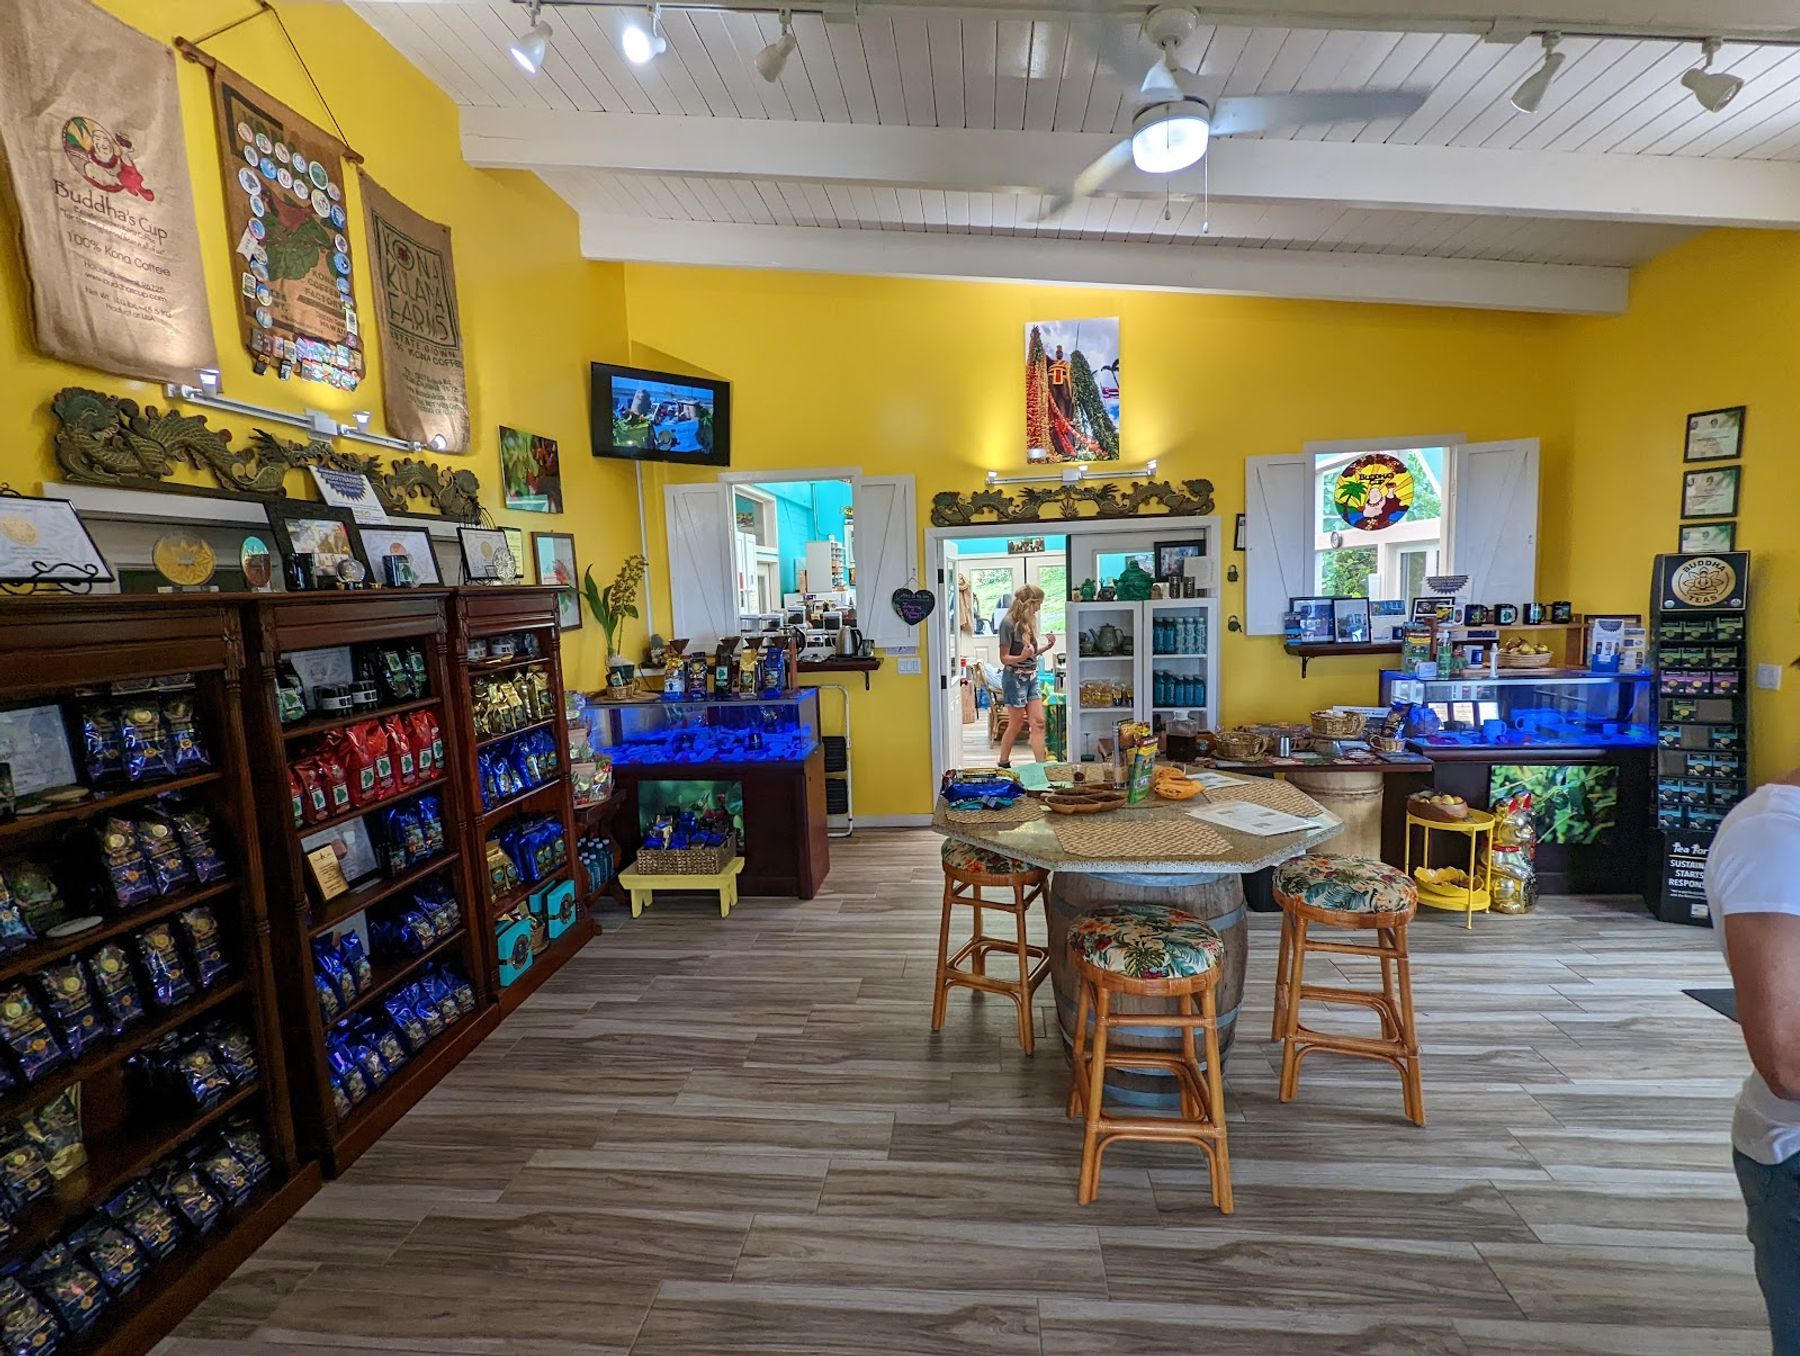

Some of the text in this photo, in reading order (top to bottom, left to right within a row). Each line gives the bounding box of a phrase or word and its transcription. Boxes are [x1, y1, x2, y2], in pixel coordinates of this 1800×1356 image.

[53, 178, 136, 226] Buddha's
[138, 216, 168, 246] Cup
[67, 231, 102, 254] 100%
[104, 245, 132, 265] Kona
[134, 257, 171, 277] Coffee
[388, 291, 448, 341] FARMS
[1682, 560, 1726, 573] BUDDHA
[1688, 595, 1718, 604] TEAS
[1672, 842, 1709, 855] Tea For
[1669, 859, 1704, 869] SUSTAIN
[1675, 869, 1704, 879] STARTS
[1668, 878, 1704, 888] RESPON
